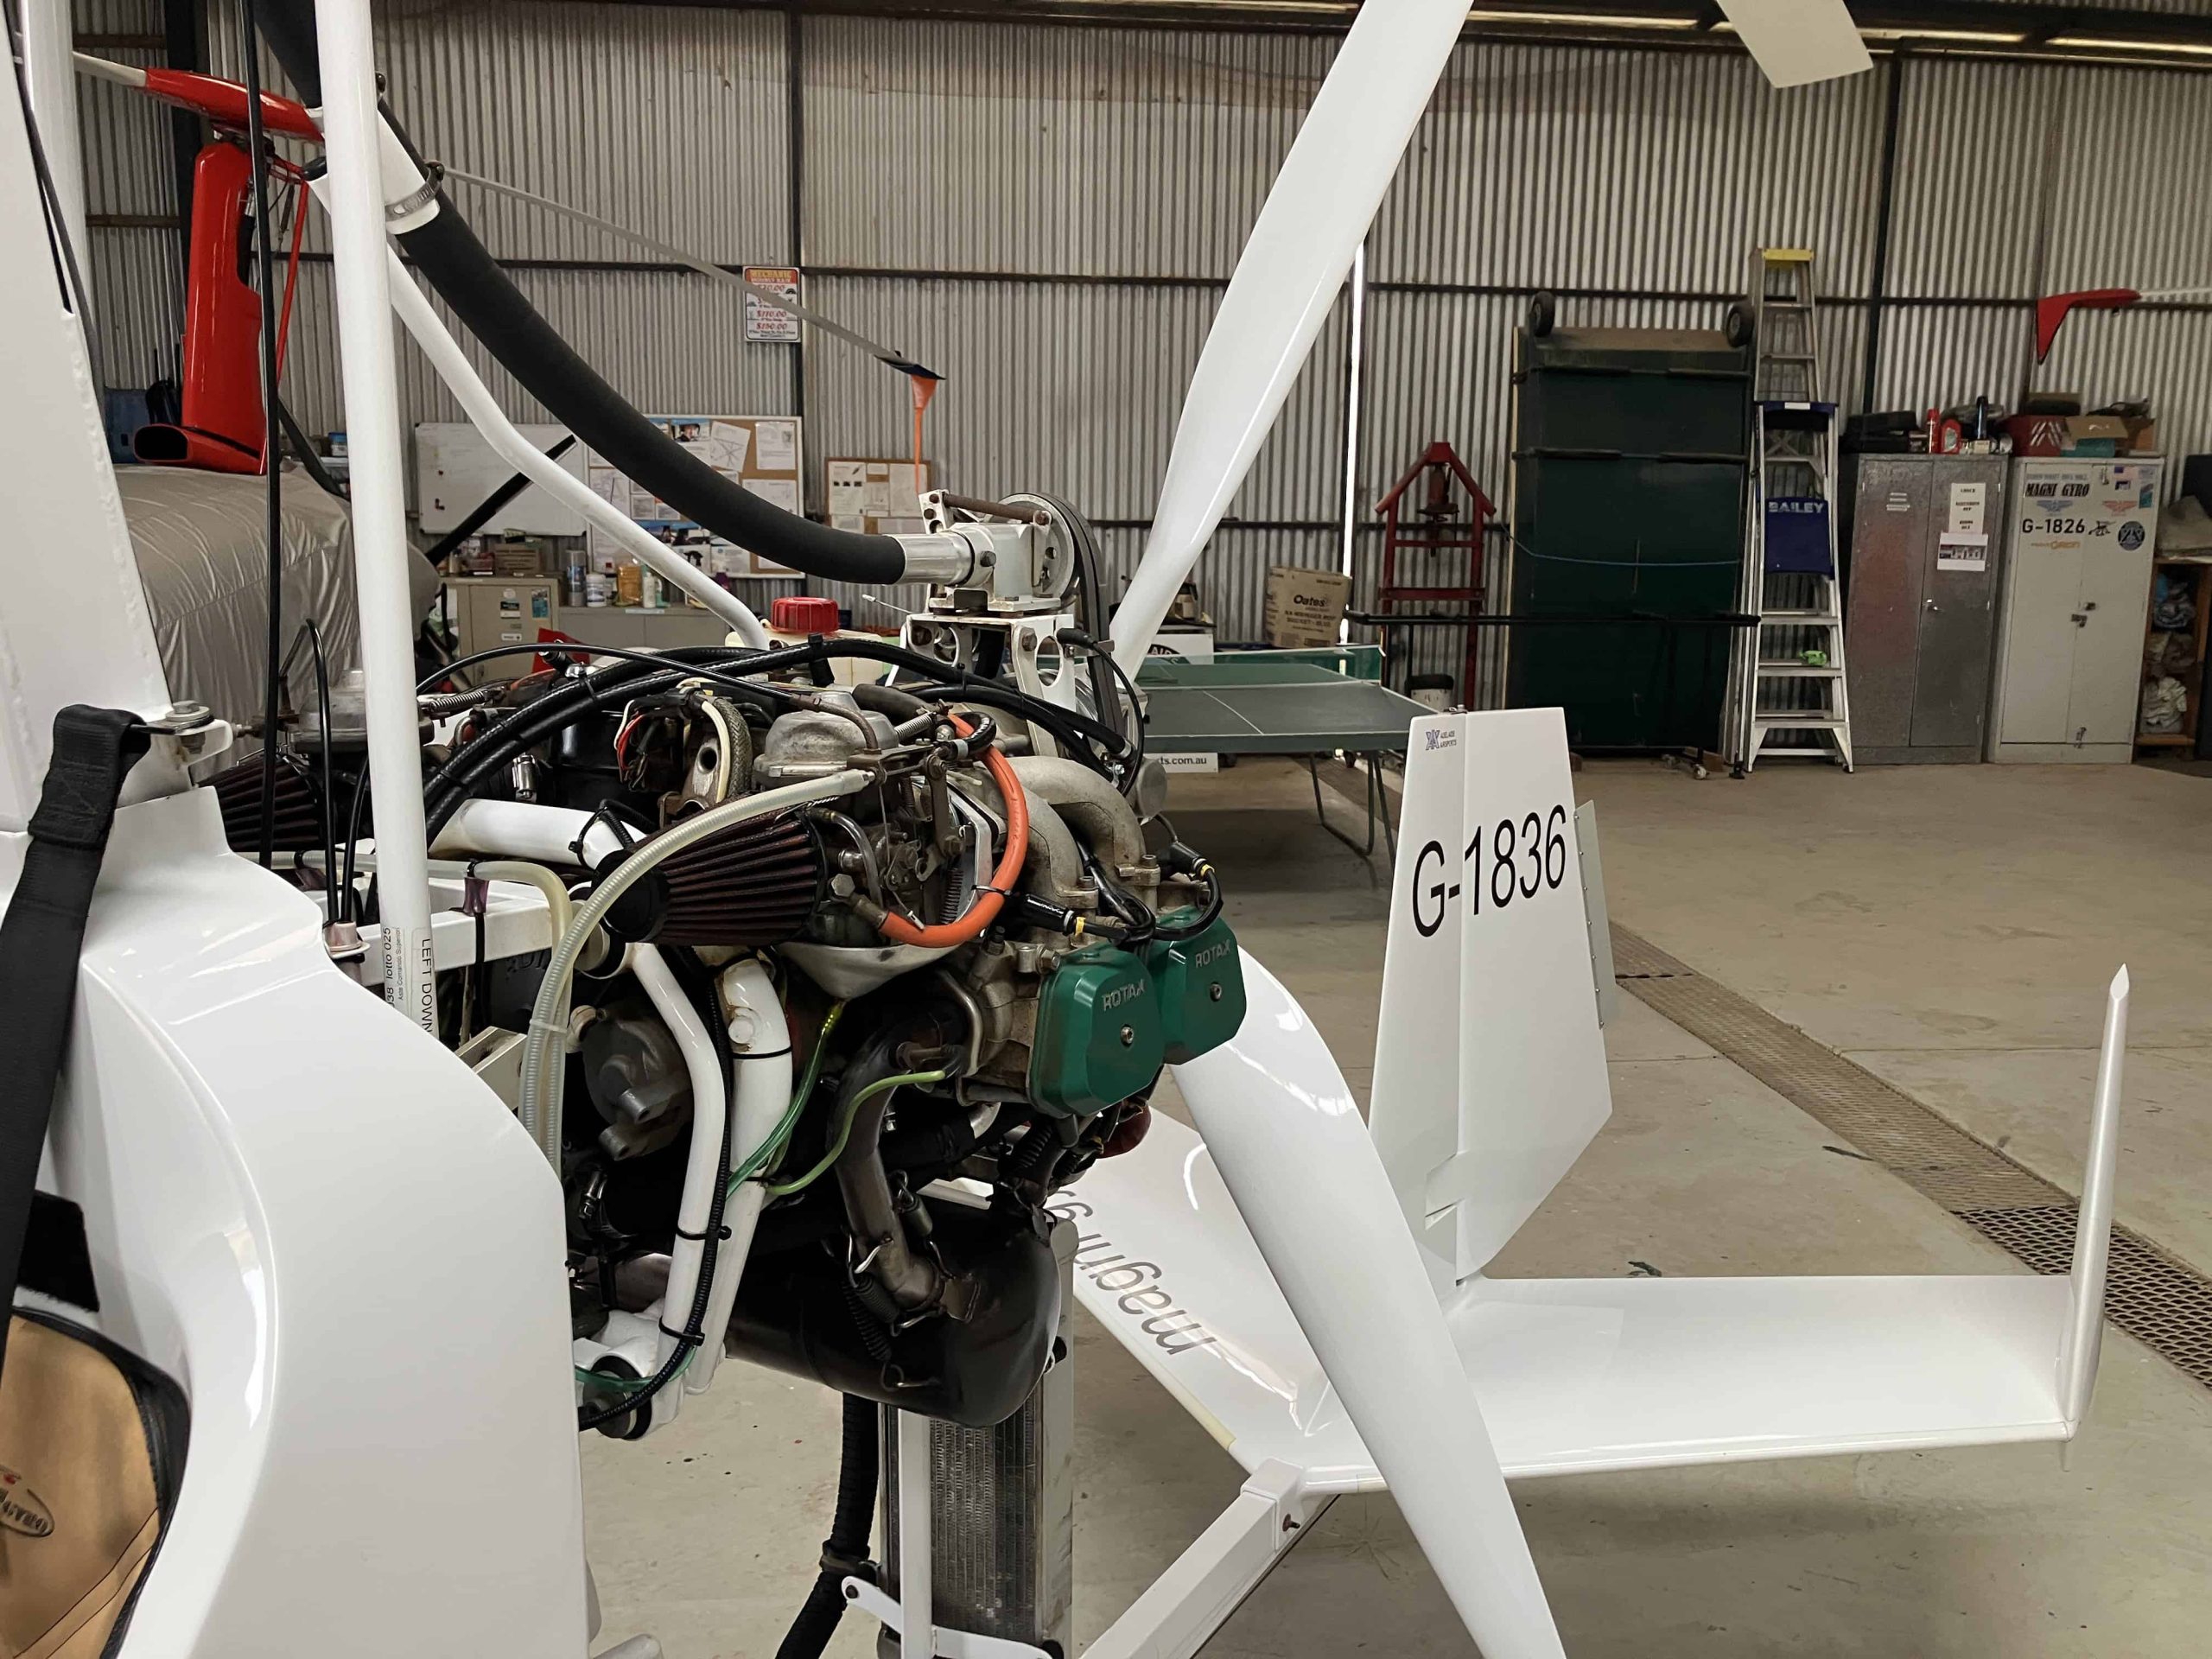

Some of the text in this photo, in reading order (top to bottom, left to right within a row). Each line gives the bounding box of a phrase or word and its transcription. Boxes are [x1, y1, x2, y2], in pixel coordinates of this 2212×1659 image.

[2025, 483, 2090, 498] MAGNI GYRO
[1768, 501, 1824, 513] BAILEY
[2022, 518, 2085, 533] G-1826
[1294, 594, 1325, 607] Oates
[1412, 804, 1567, 938] G-1836
[383, 927, 391, 950] 025
[1195, 938, 1231, 969] ROTAX
[422, 938, 433, 1033] LEFT DOWN
[1103, 978, 1145, 1012] ROTAX
